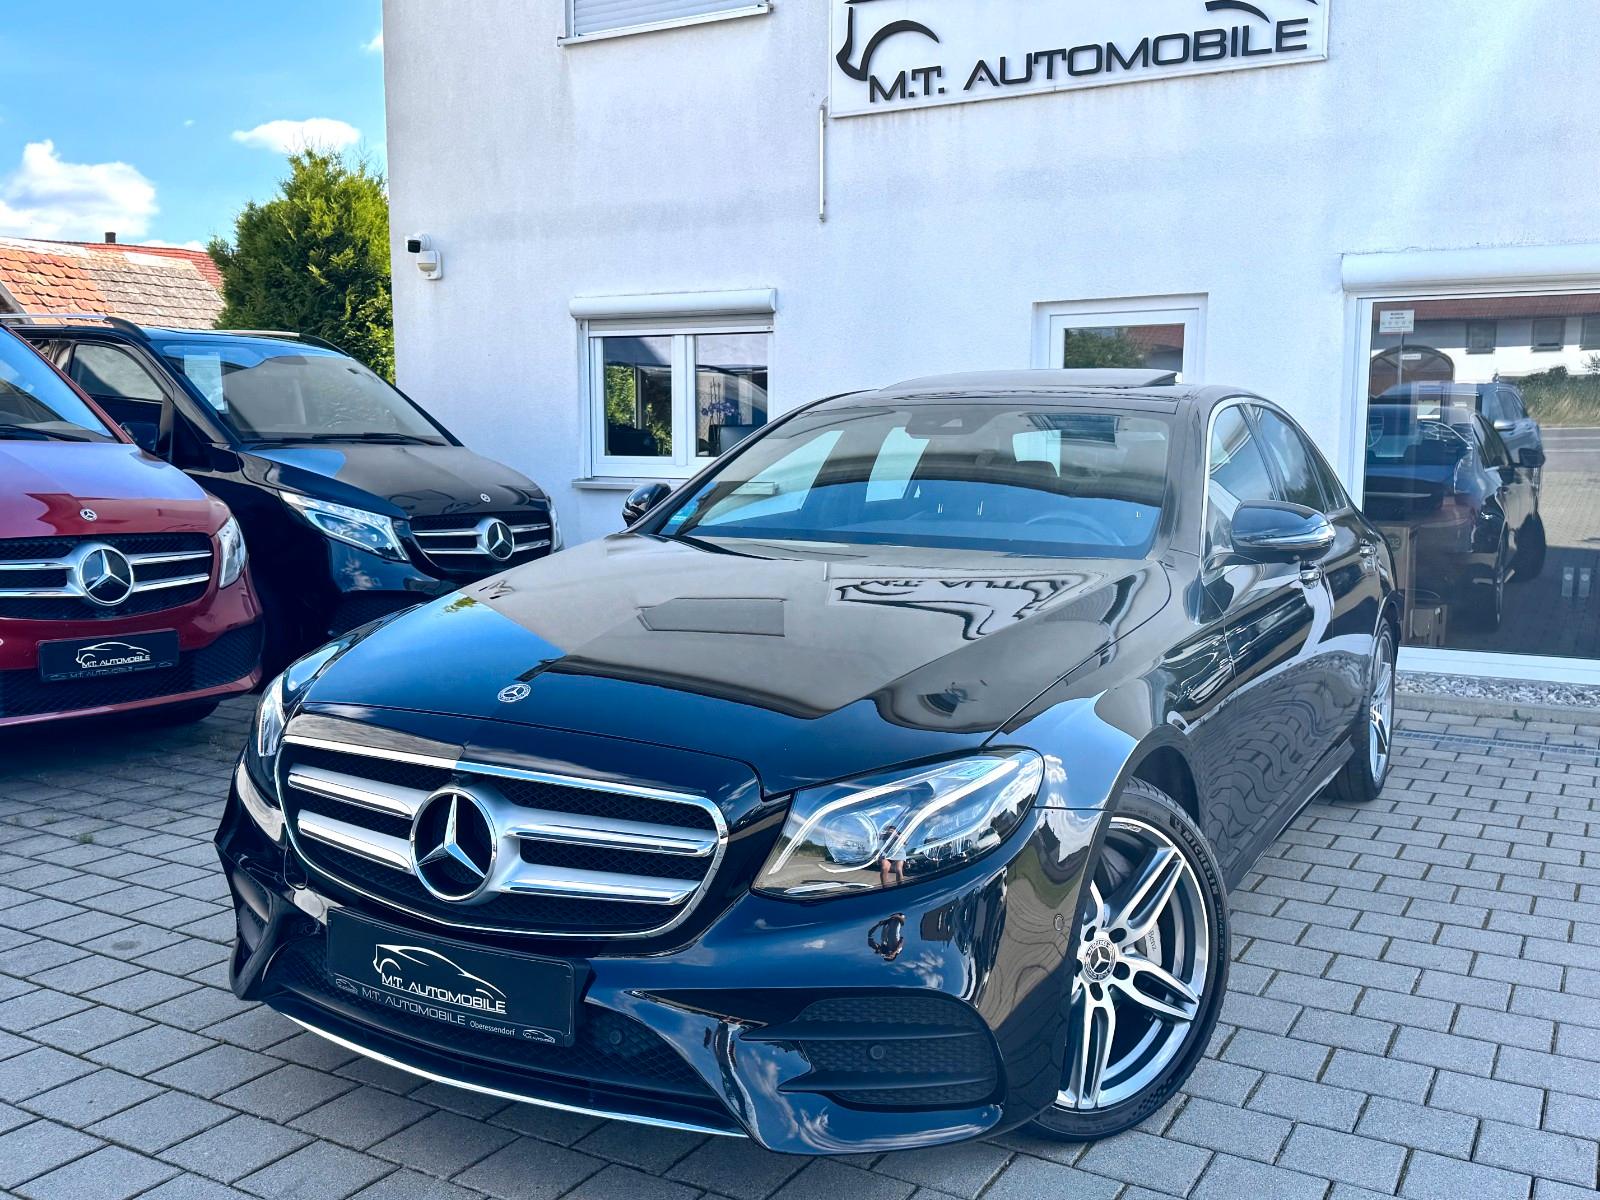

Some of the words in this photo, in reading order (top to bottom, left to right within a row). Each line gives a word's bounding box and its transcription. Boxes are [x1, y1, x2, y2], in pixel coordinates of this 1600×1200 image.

[869, 65, 945, 103] M.T.
[963, 17, 1309, 91] AUTOMOBILE
[100, 655, 150, 667] AUTOMOBILE
[1182, 830, 1219, 895] MICHELIN
[1149, 929, 1157, 951] Benz
[362, 987, 381, 1002] M.T.
[384, 996, 466, 1026] AUTOMOBILE
[470, 1020, 516, 1037] Oberessendorf
[382, 972, 404, 990] M.T.
[408, 981, 506, 1013] AUTOMOBILE
